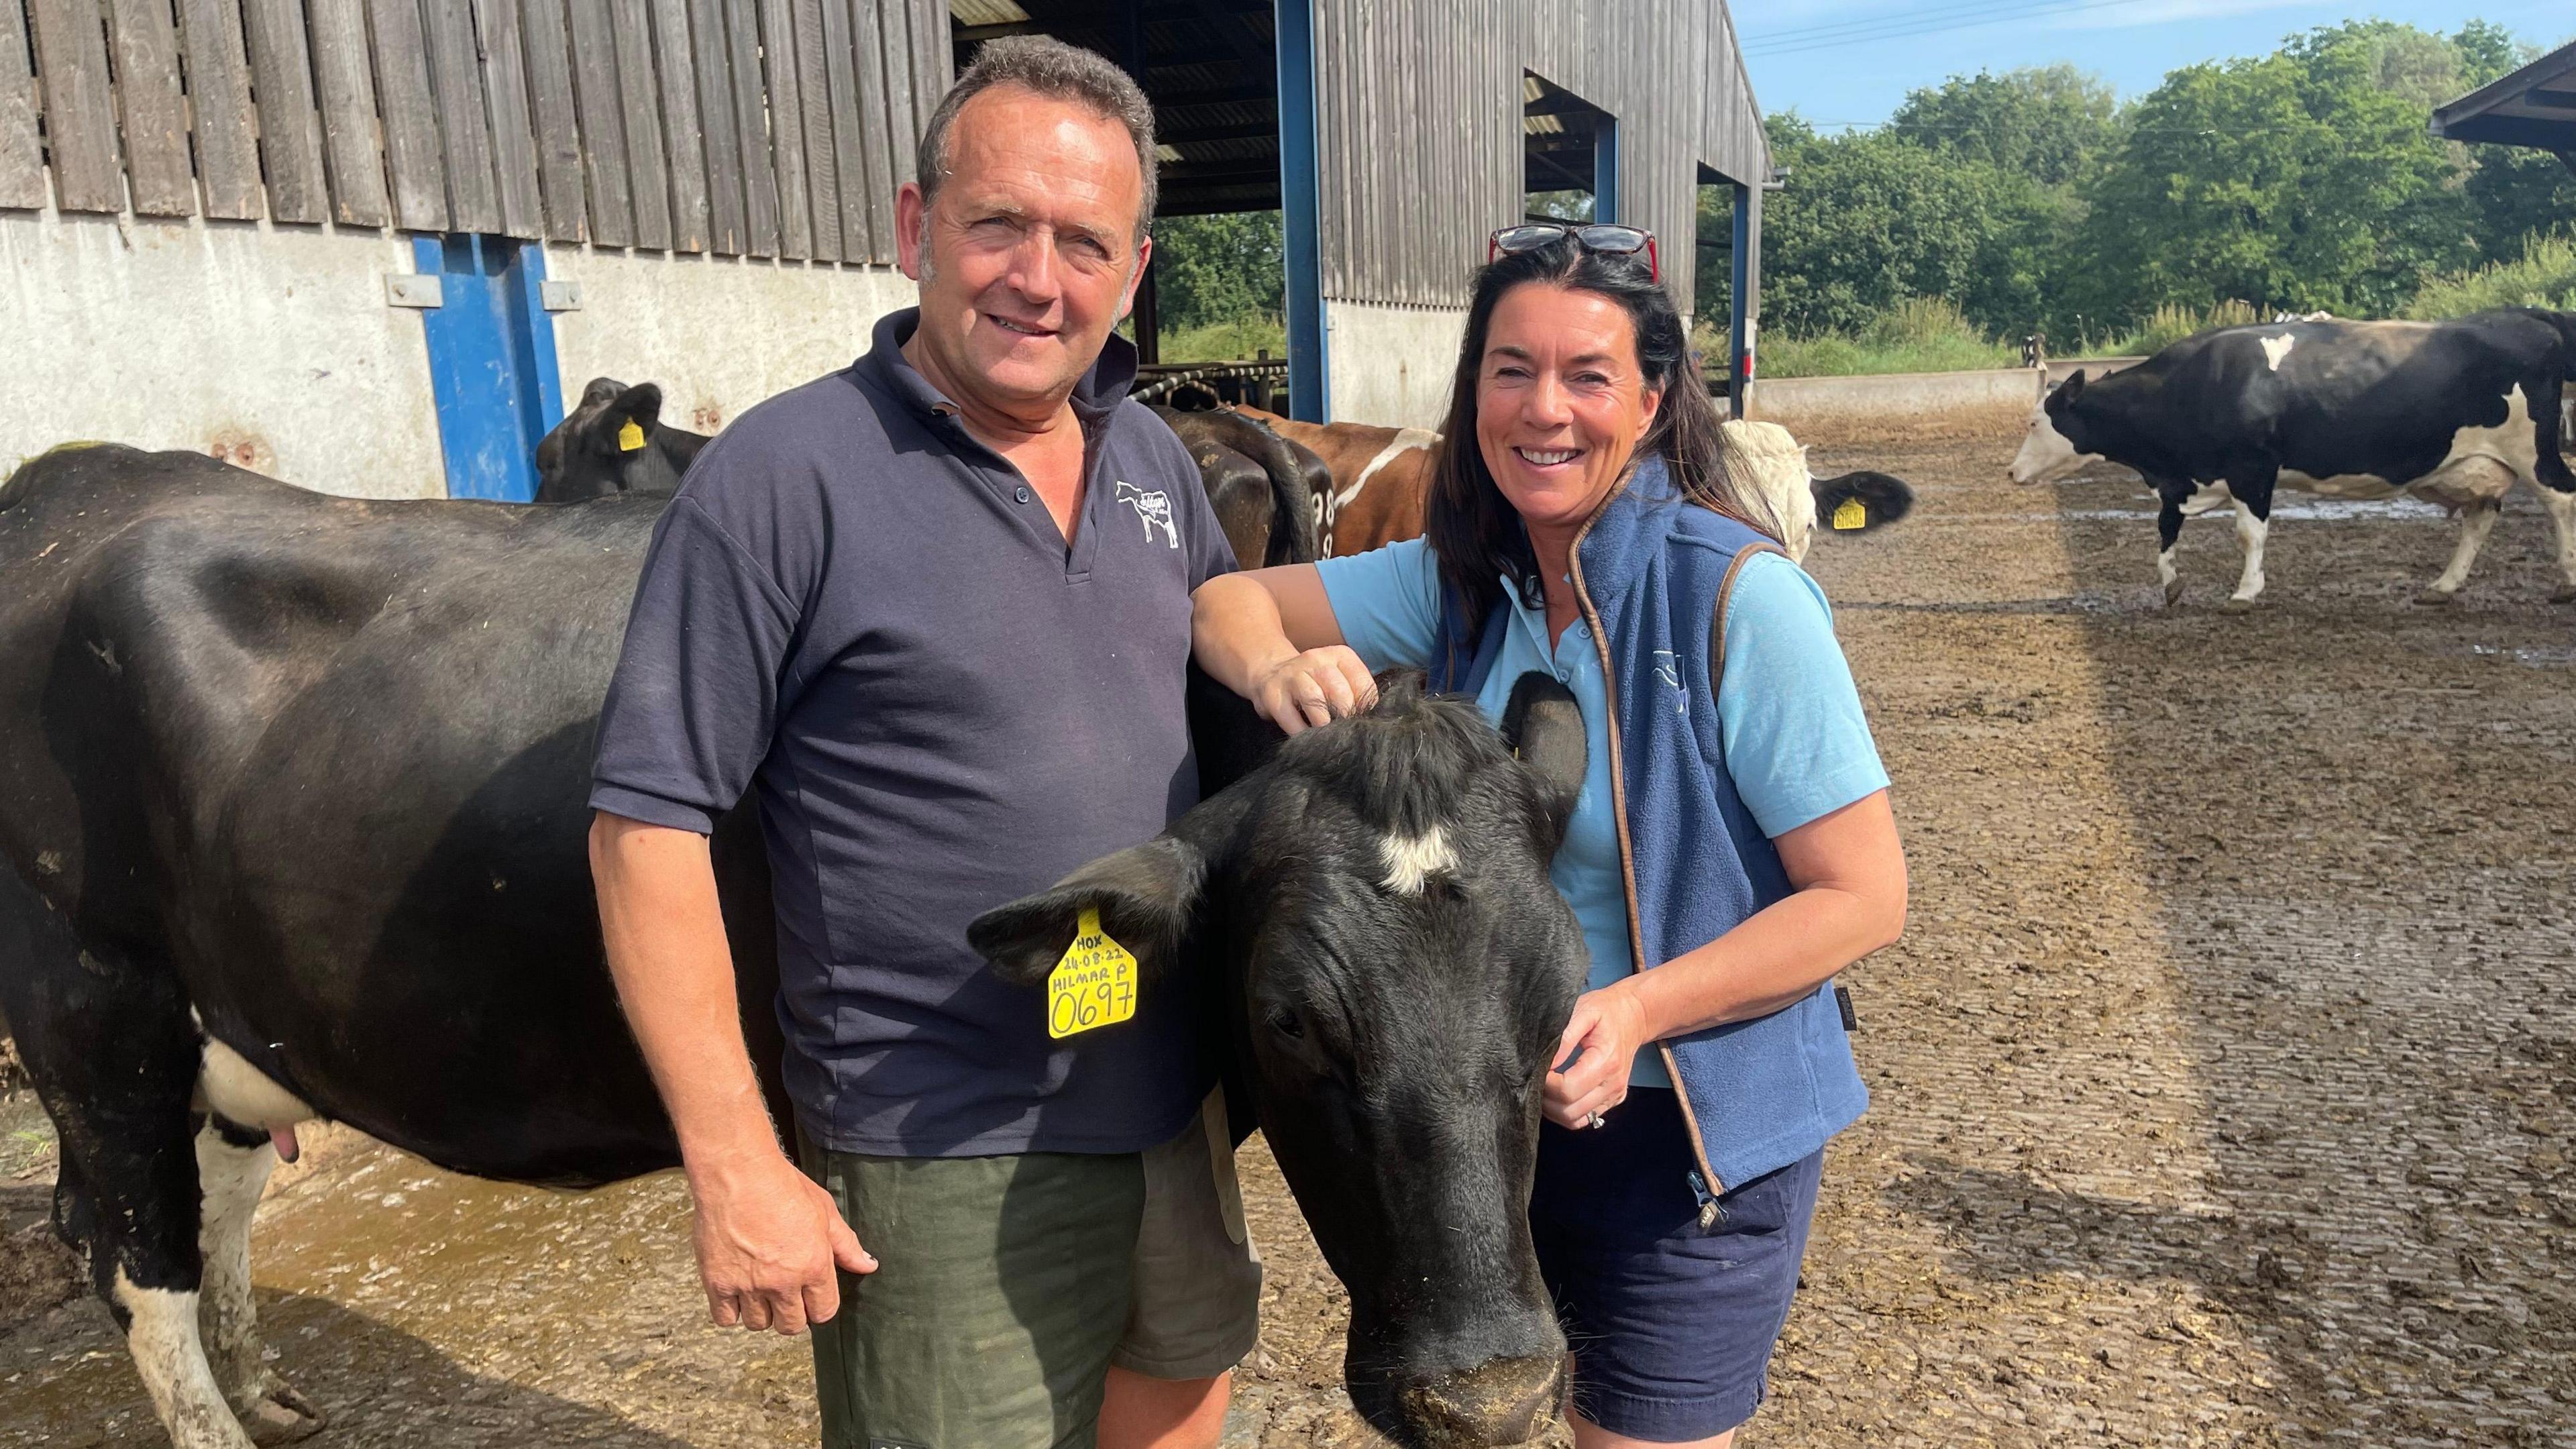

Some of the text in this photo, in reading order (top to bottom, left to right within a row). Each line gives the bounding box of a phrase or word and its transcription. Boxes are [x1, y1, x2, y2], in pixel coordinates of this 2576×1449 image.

[1076, 934, 1102, 951] HOX
[1053, 963, 1127, 993] HILMAR P
[1051, 981, 1133, 1034] 0697
